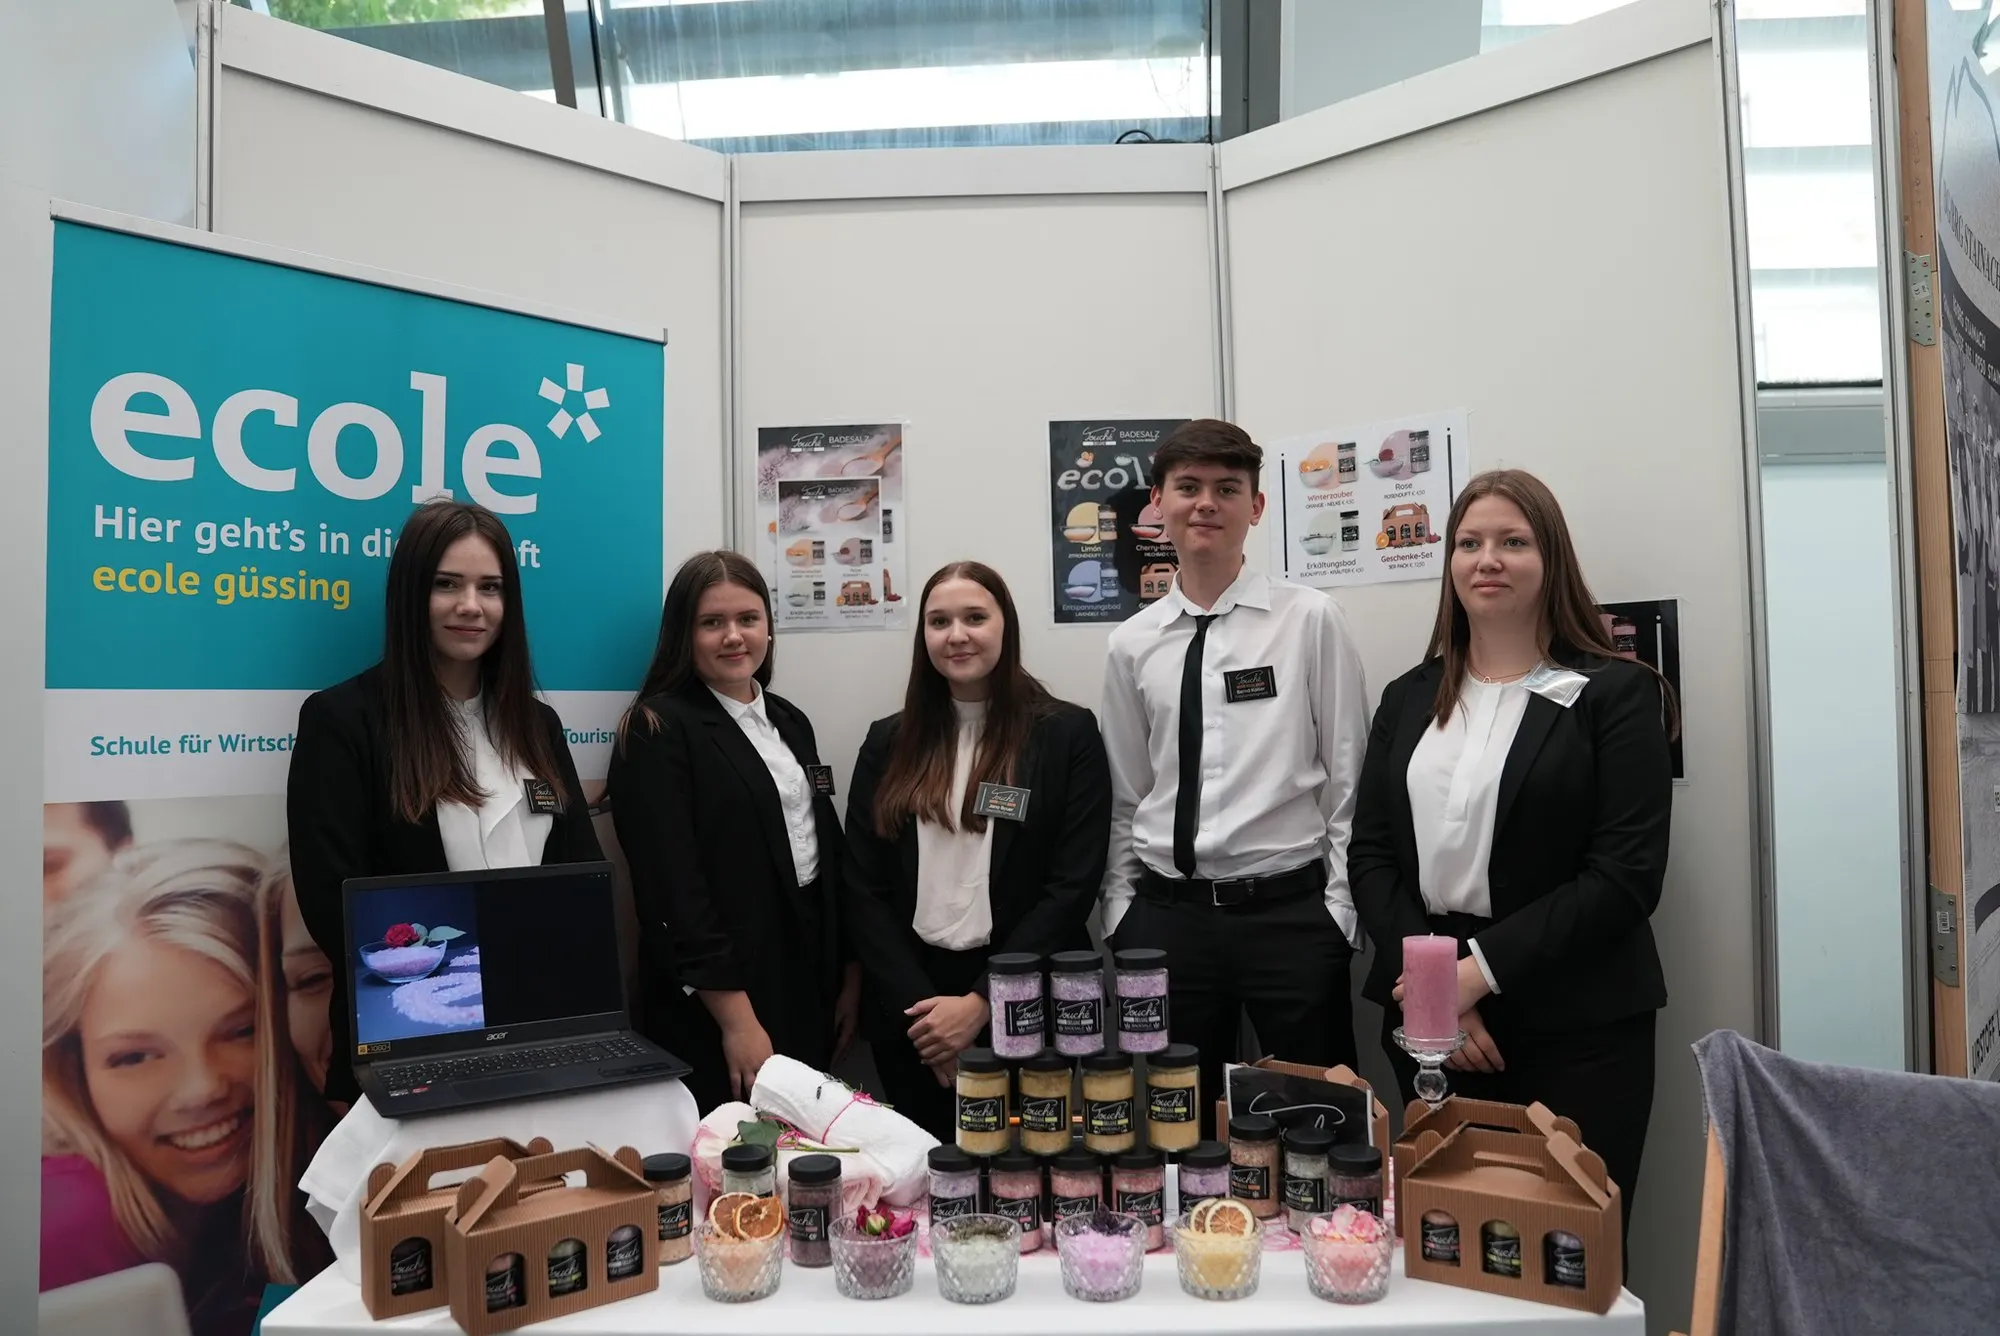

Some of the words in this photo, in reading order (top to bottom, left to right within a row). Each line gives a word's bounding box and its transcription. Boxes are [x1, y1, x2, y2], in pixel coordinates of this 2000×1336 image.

[90, 370, 542, 514] ecole
[1119, 430, 1160, 439] BADESALZ
[1307, 490, 1354, 501] Winterzauber
[95, 504, 182, 543] Hier
[194, 517, 306, 555] geht's
[319, 523, 350, 556] in
[1381, 551, 1433, 562] Geschenke-Set
[93, 562, 200, 595] ecole
[214, 565, 350, 610] güssing
[91, 735, 171, 756] Schule
[179, 734, 212, 754] für
[486, 1031, 509, 1041] acer
